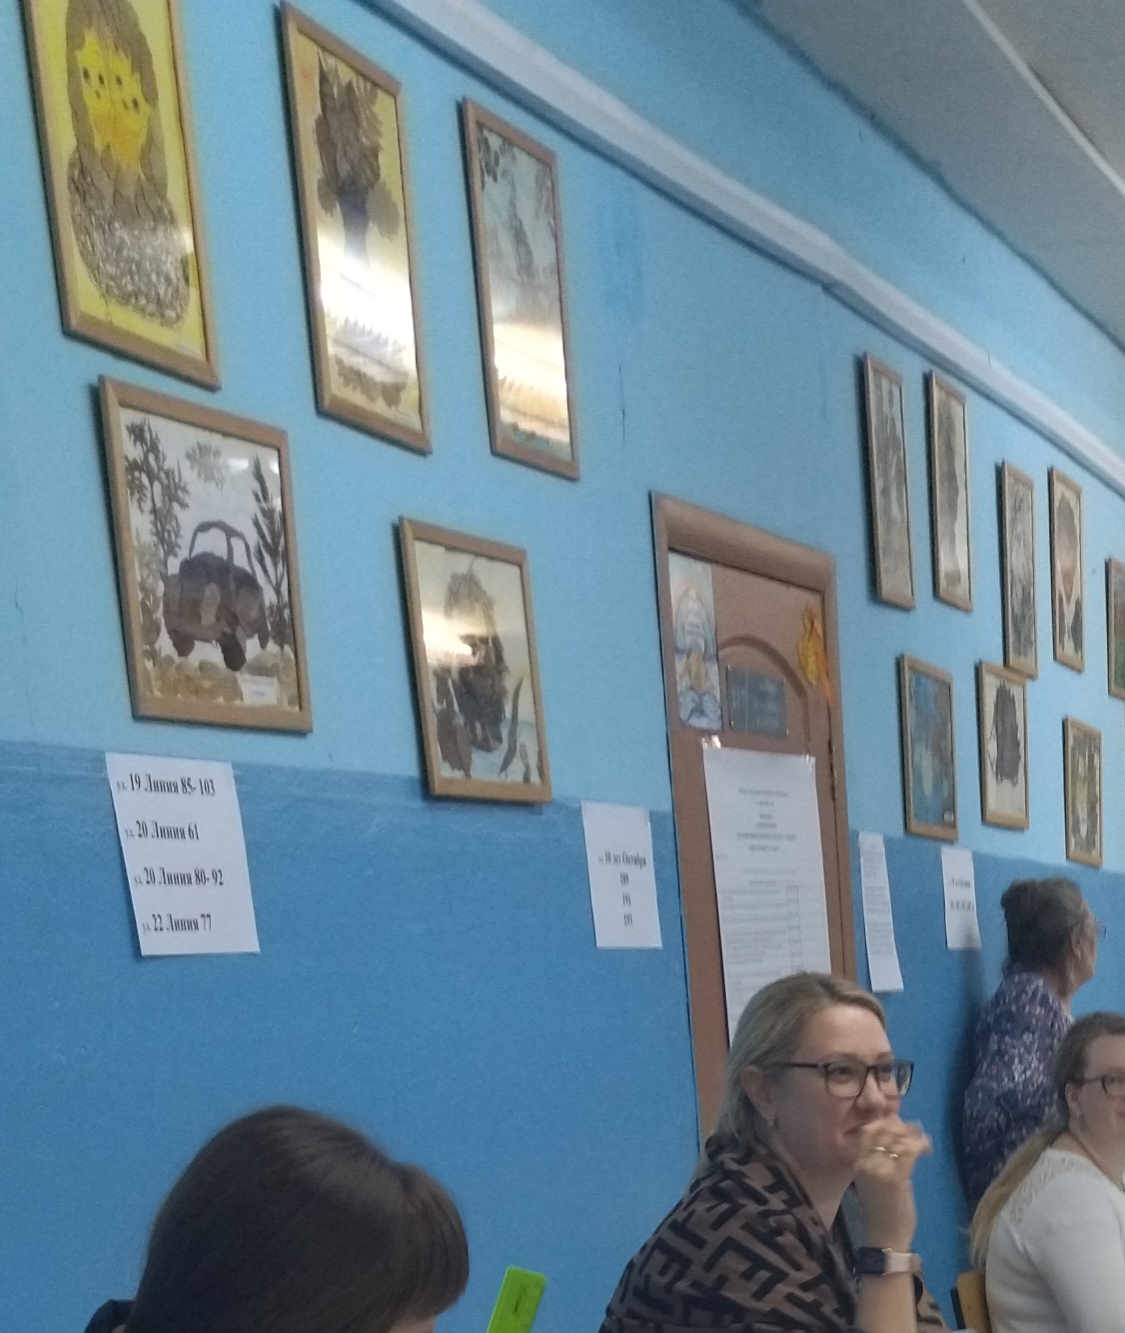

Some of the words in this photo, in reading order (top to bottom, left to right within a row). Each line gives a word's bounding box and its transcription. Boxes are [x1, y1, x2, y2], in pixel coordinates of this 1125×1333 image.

[129, 773, 141, 791] 19
[144, 774, 179, 793] Линия
[199, 778, 216, 796] 103
[136, 820, 148, 838] 20
[151, 821, 185, 840] Линия
[188, 822, 200, 841] 61
[144, 867, 155, 885] 20
[158, 867, 193, 886] Линия
[212, 869, 224, 886] 92
[152, 914, 163, 932] 22
[166, 913, 199, 932] Линия
[201, 913, 212, 932] 77
